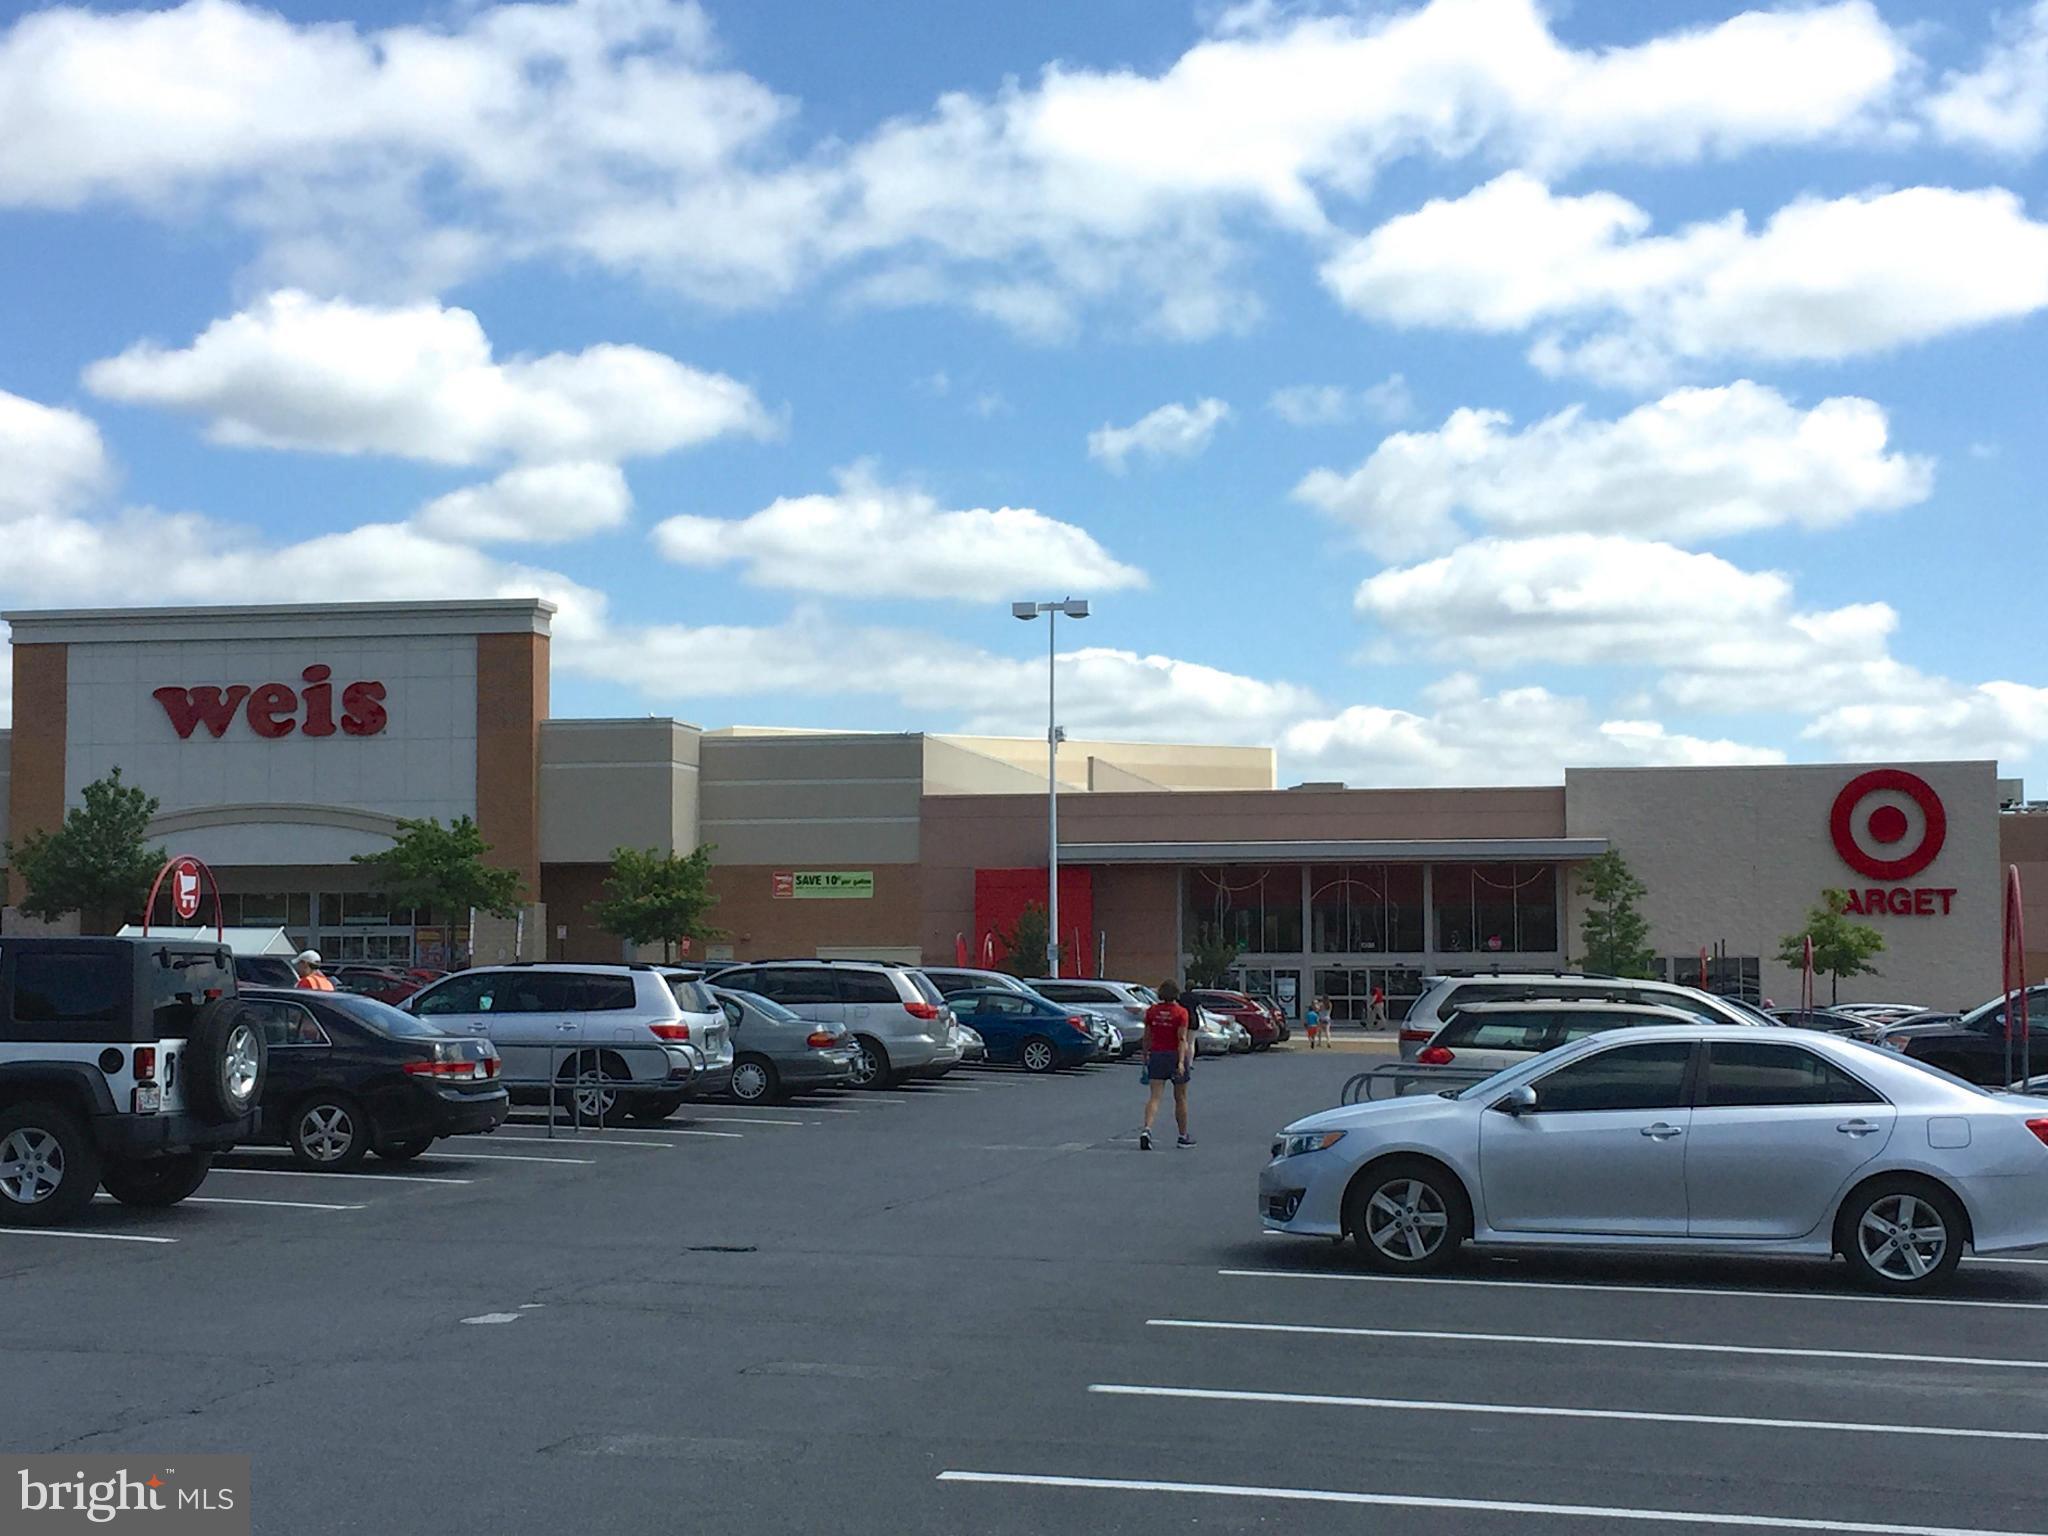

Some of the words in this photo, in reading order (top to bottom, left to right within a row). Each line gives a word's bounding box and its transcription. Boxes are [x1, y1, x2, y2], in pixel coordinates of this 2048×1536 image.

[152, 664, 388, 739] weis
[795, 875, 822, 886] SAVE
[1839, 887, 1958, 916] ARGET
